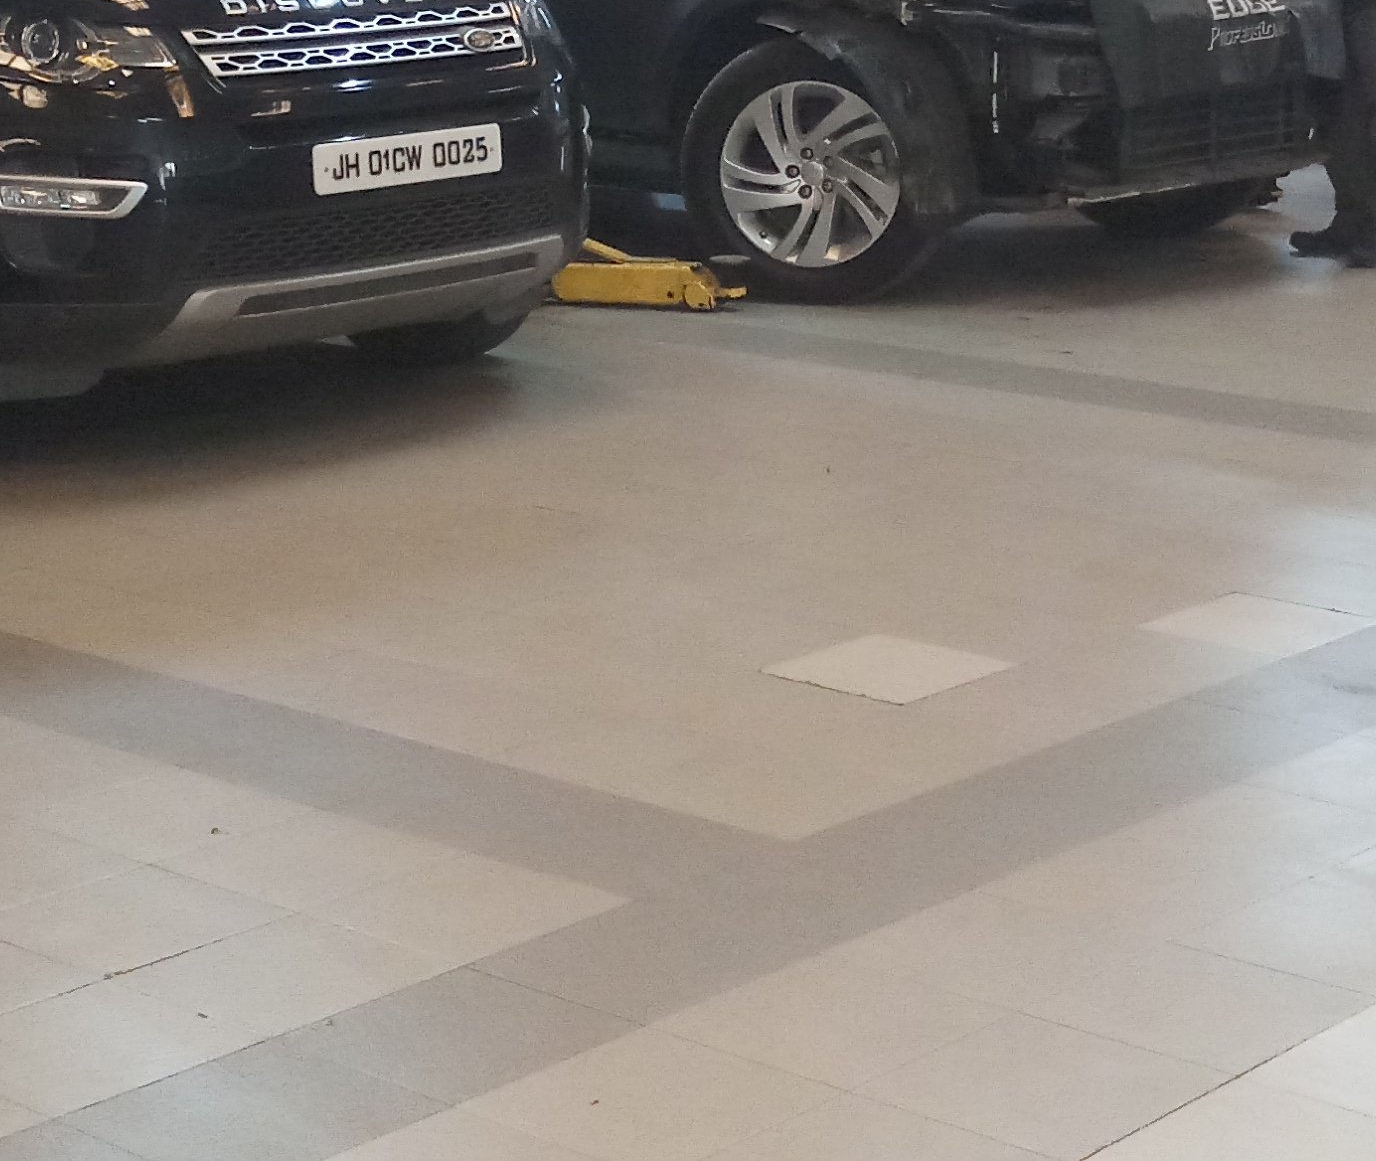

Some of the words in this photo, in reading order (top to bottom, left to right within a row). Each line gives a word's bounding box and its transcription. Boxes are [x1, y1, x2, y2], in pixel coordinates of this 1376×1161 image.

[332, 152, 361, 181] JH
[368, 145, 423, 177] 01CW
[432, 136, 489, 169] 0025
